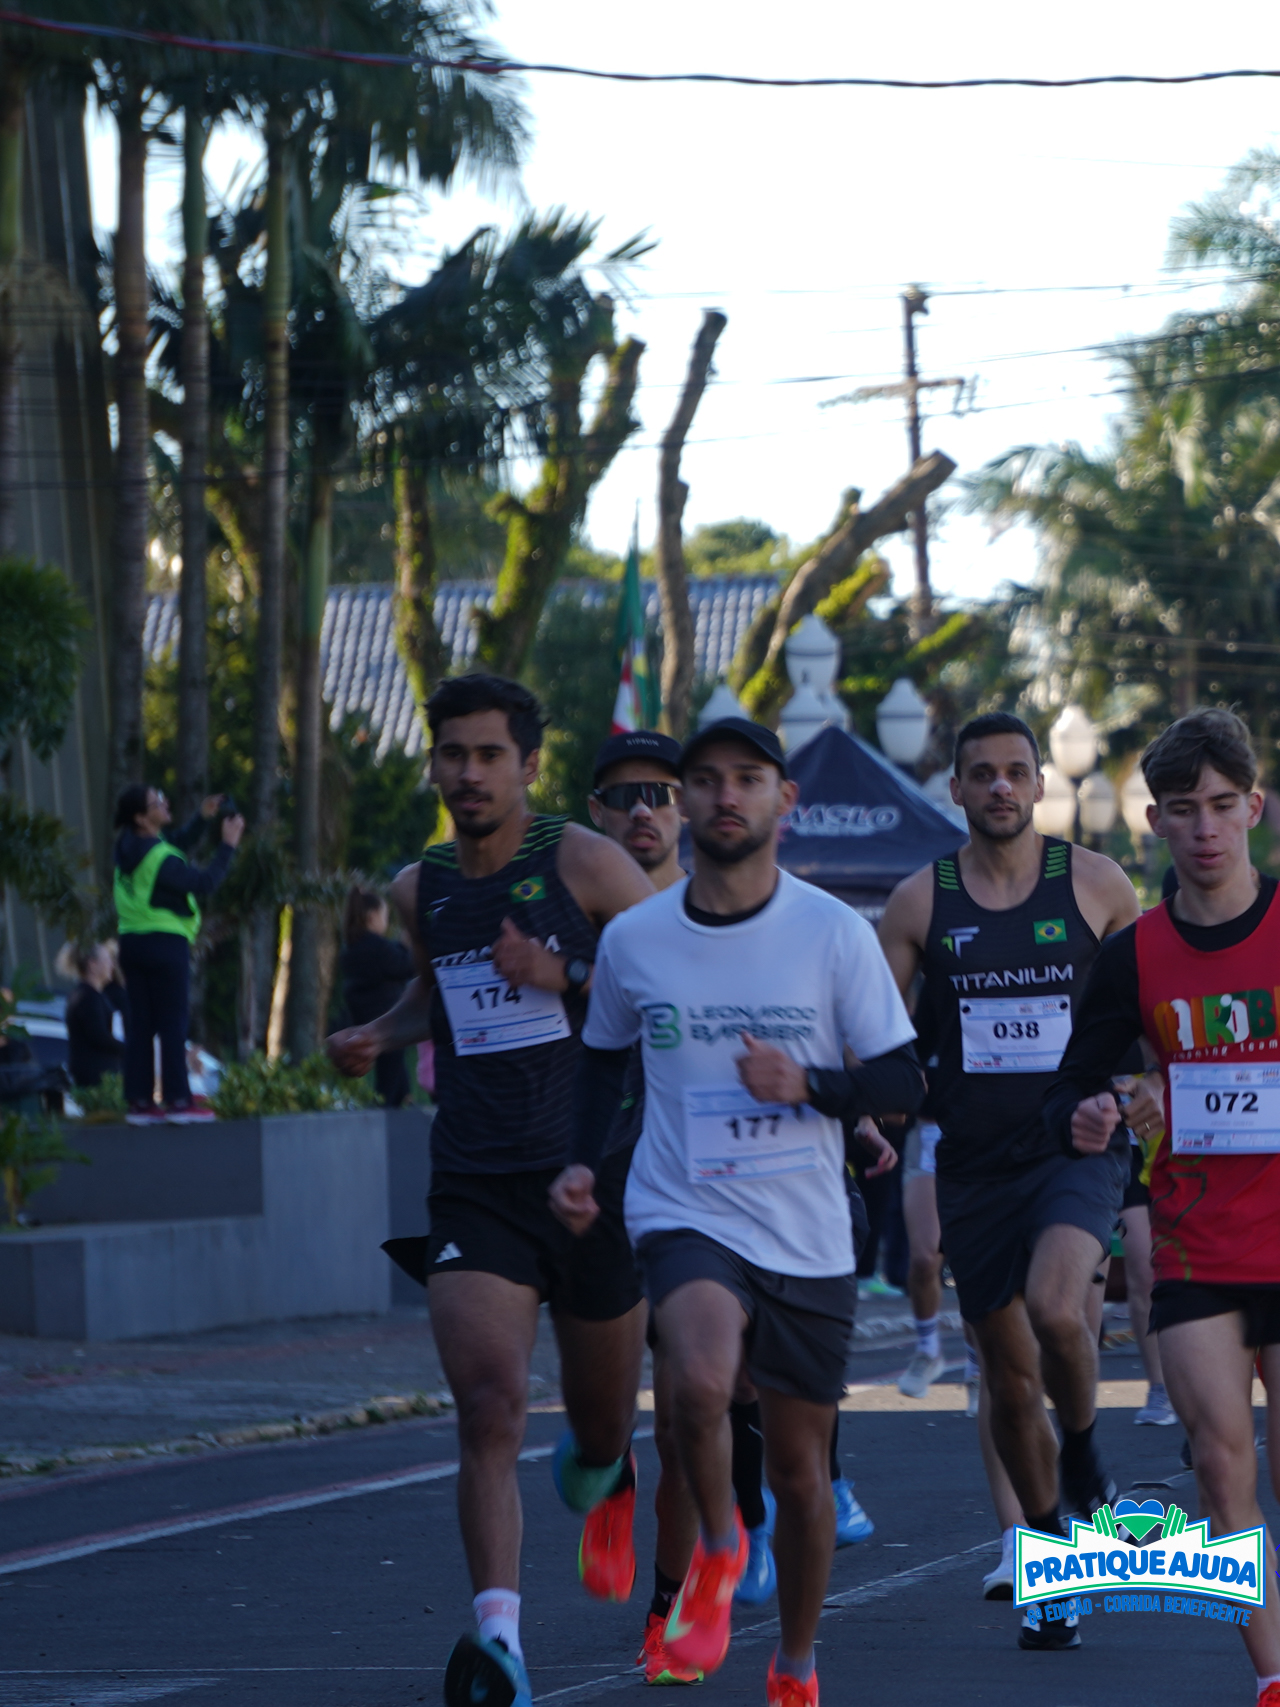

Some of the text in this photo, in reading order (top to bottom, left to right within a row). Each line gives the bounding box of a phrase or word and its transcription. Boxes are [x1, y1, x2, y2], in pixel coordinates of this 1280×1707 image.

[949, 963, 1074, 991] TITANIUM
[471, 985, 522, 1010] 174
[993, 1021, 1040, 1040] 038
[1205, 1091, 1259, 1115] 072
[725, 1114, 783, 1140] 177
